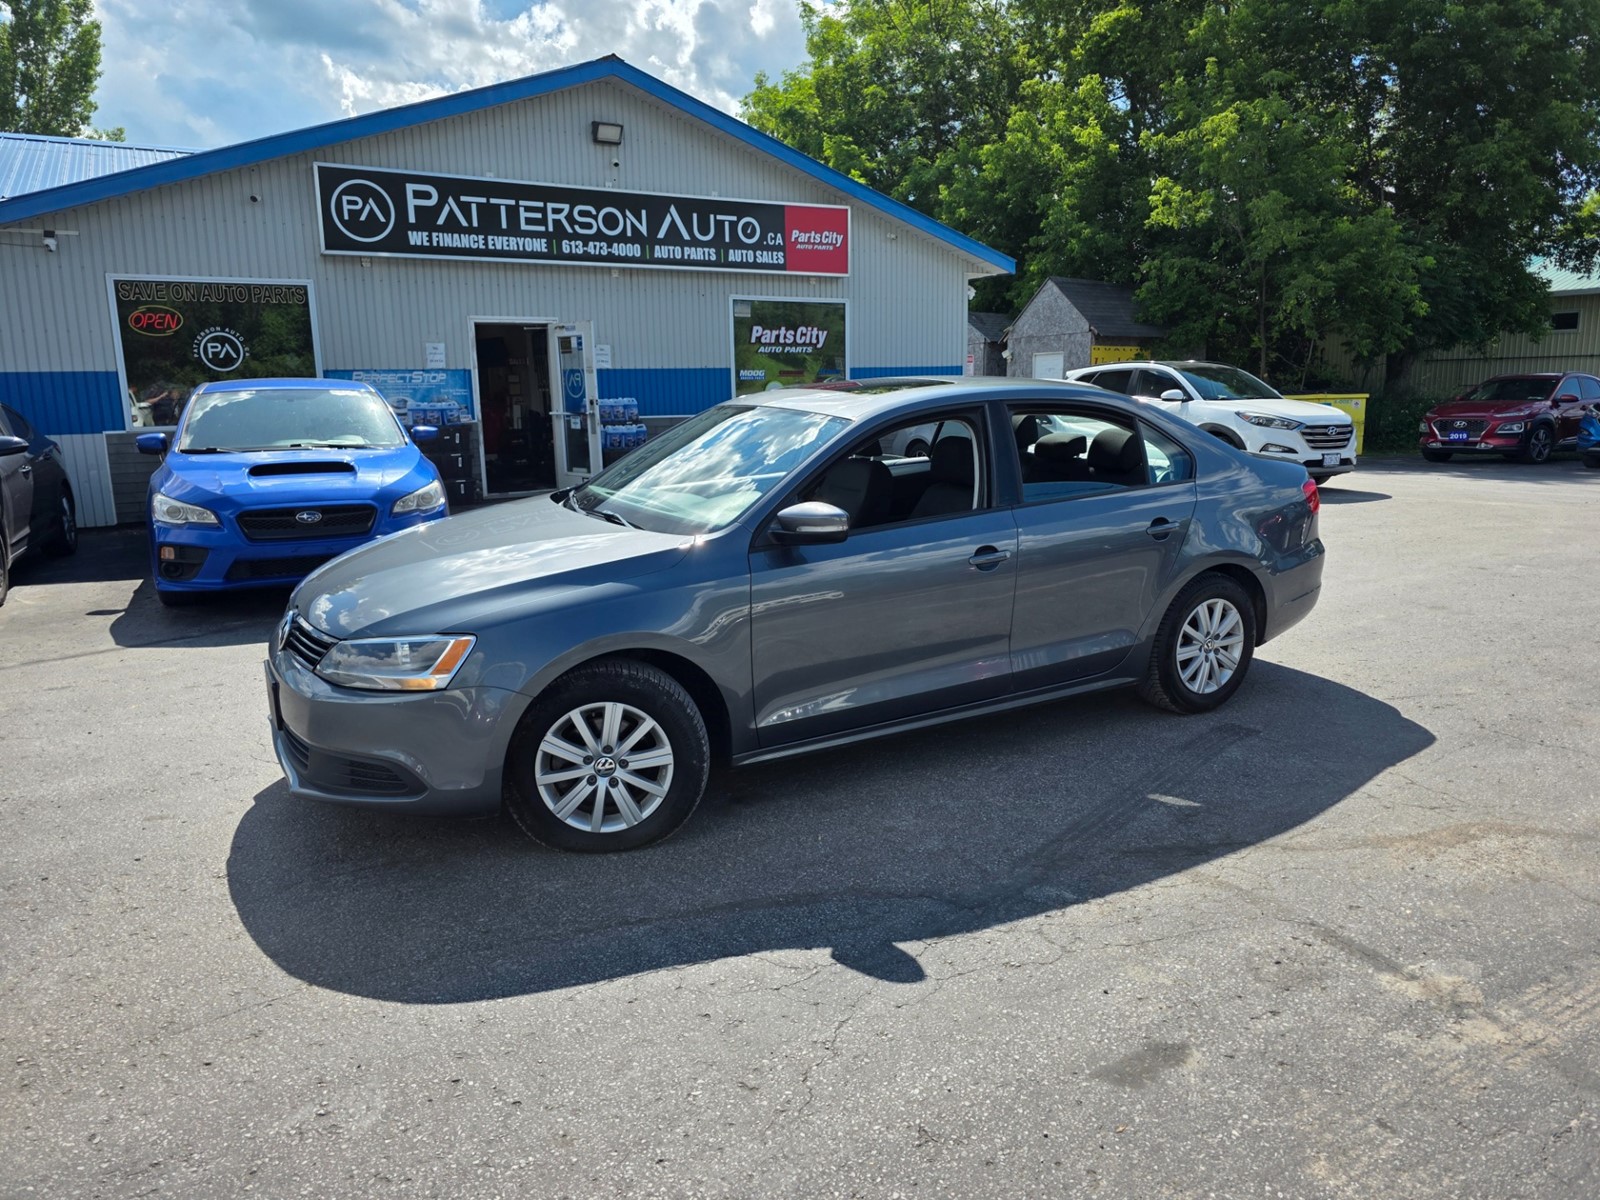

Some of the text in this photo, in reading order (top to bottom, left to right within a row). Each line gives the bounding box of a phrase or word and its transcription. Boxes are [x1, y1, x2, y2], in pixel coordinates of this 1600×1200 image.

[341, 195, 386, 222] PA
[405, 183, 648, 237] PATTERSON
[656, 203, 761, 244] AUTO
[408, 230, 785, 265] WE FINANCE EVERYONE 613-473-4000 AUTO PARTS AUTO SALES
[118, 281, 306, 305] SAVE ON AUTO PARTS
[131, 312, 178, 330] OPEN
[207, 342, 238, 359] PA
[739, 369, 766, 377] MOOG
